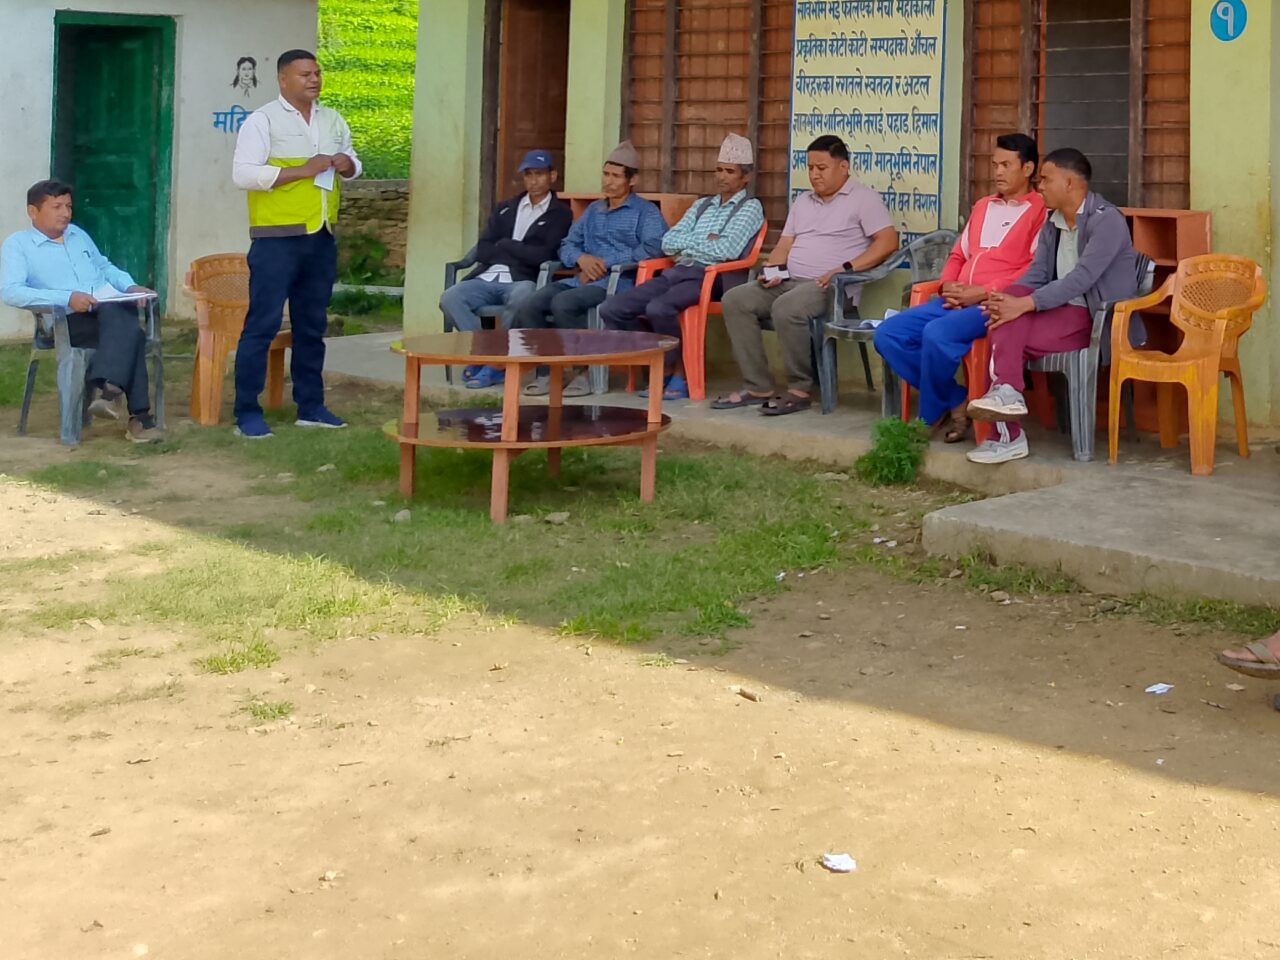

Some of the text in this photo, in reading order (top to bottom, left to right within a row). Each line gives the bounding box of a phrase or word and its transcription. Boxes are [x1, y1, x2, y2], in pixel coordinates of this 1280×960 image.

[1216, 1, 1234, 37] १
[902, 75, 932, 101] अटल
[912, 145, 938, 179] नेपाल
